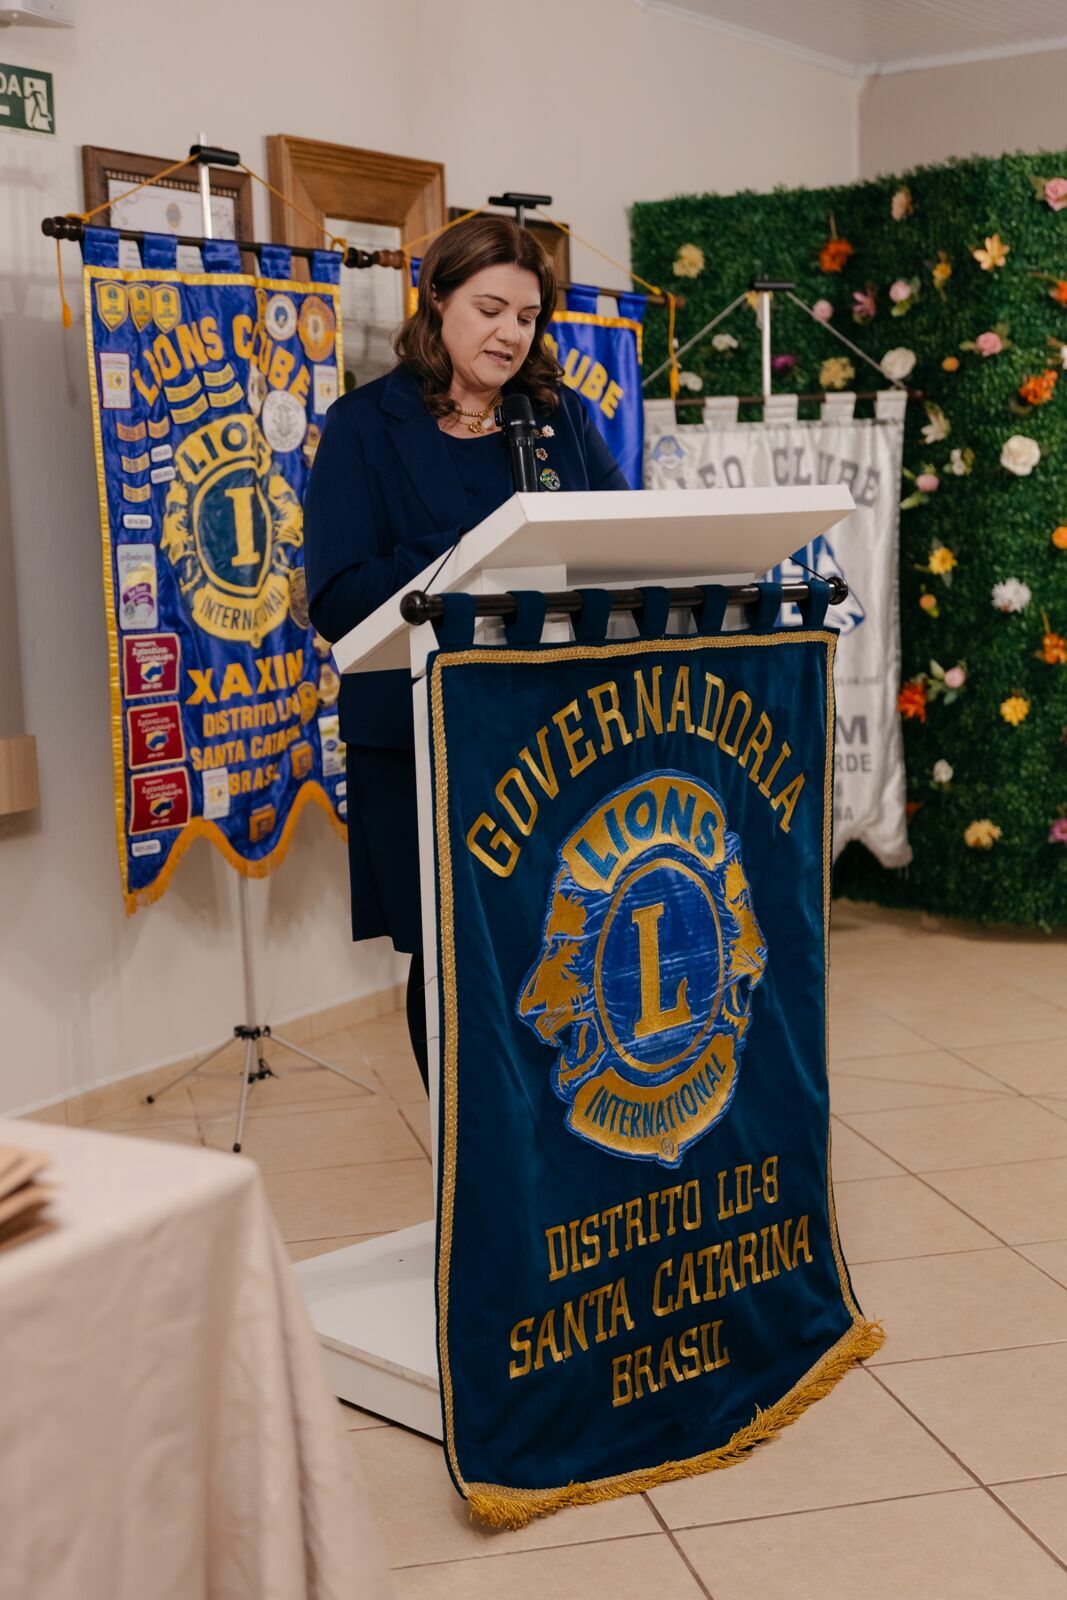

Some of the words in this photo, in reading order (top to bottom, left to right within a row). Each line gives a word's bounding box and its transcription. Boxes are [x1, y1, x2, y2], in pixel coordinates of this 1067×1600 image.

[133, 315, 225, 407] LIONS
[233, 314, 311, 408] CUBE
[544, 333, 624, 419] UBE
[190, 739, 246, 771] SANTA
[203, 701, 277, 739] DISTRITO
[228, 762, 281, 796] BRASL
[465, 663, 807, 879] GOVERNADORIA
[574, 785, 720, 881] LIONS
[632, 902, 692, 1040] L
[584, 1051, 728, 1139] INTERNATIONAL
[545, 1179, 702, 1282] DISTRITO
[716, 1155, 779, 1222] LD-8
[509, 1276, 635, 1381] SANTA
[652, 1215, 813, 1318] CATARINA
[611, 1320, 731, 1408] BRASIL
